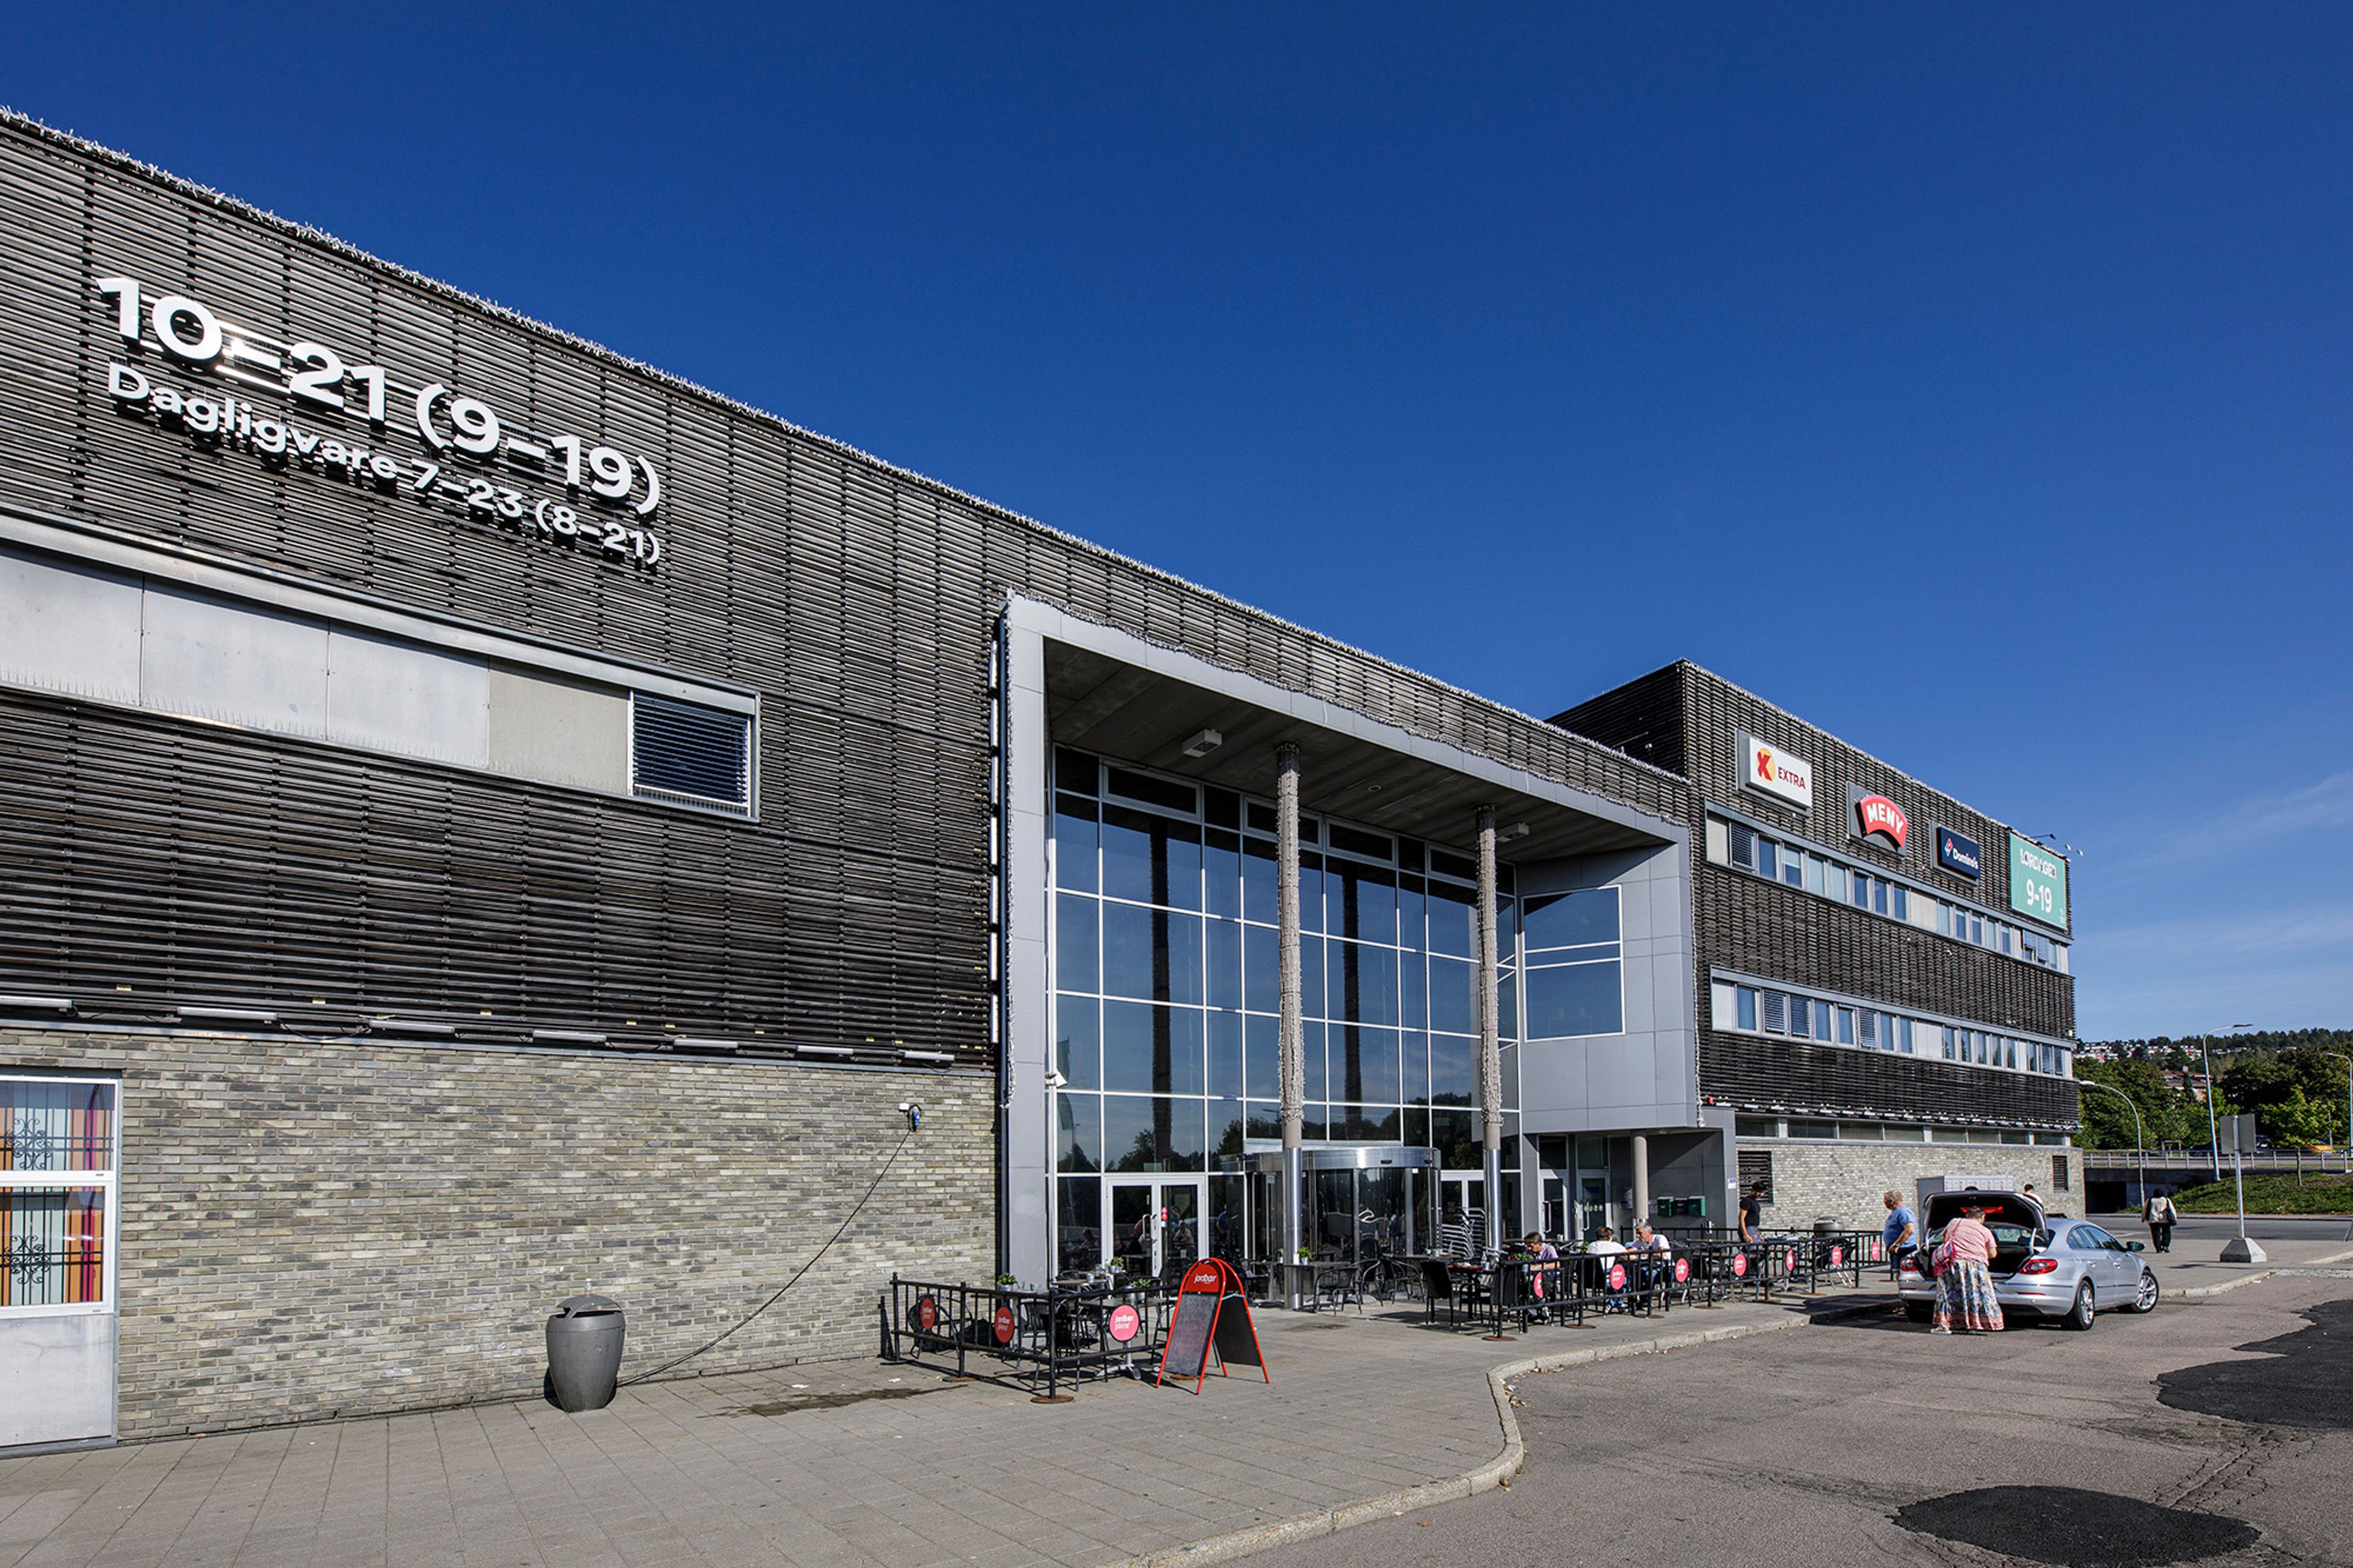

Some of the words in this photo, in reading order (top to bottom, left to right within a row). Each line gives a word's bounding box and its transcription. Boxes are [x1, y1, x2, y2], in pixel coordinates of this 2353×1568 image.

[108, 363, 398, 480] Dagligvare
[1778, 766, 1806, 789] EXTRA
[1866, 803, 1904, 834] MENY
[2026, 879, 2052, 914] 9-19
